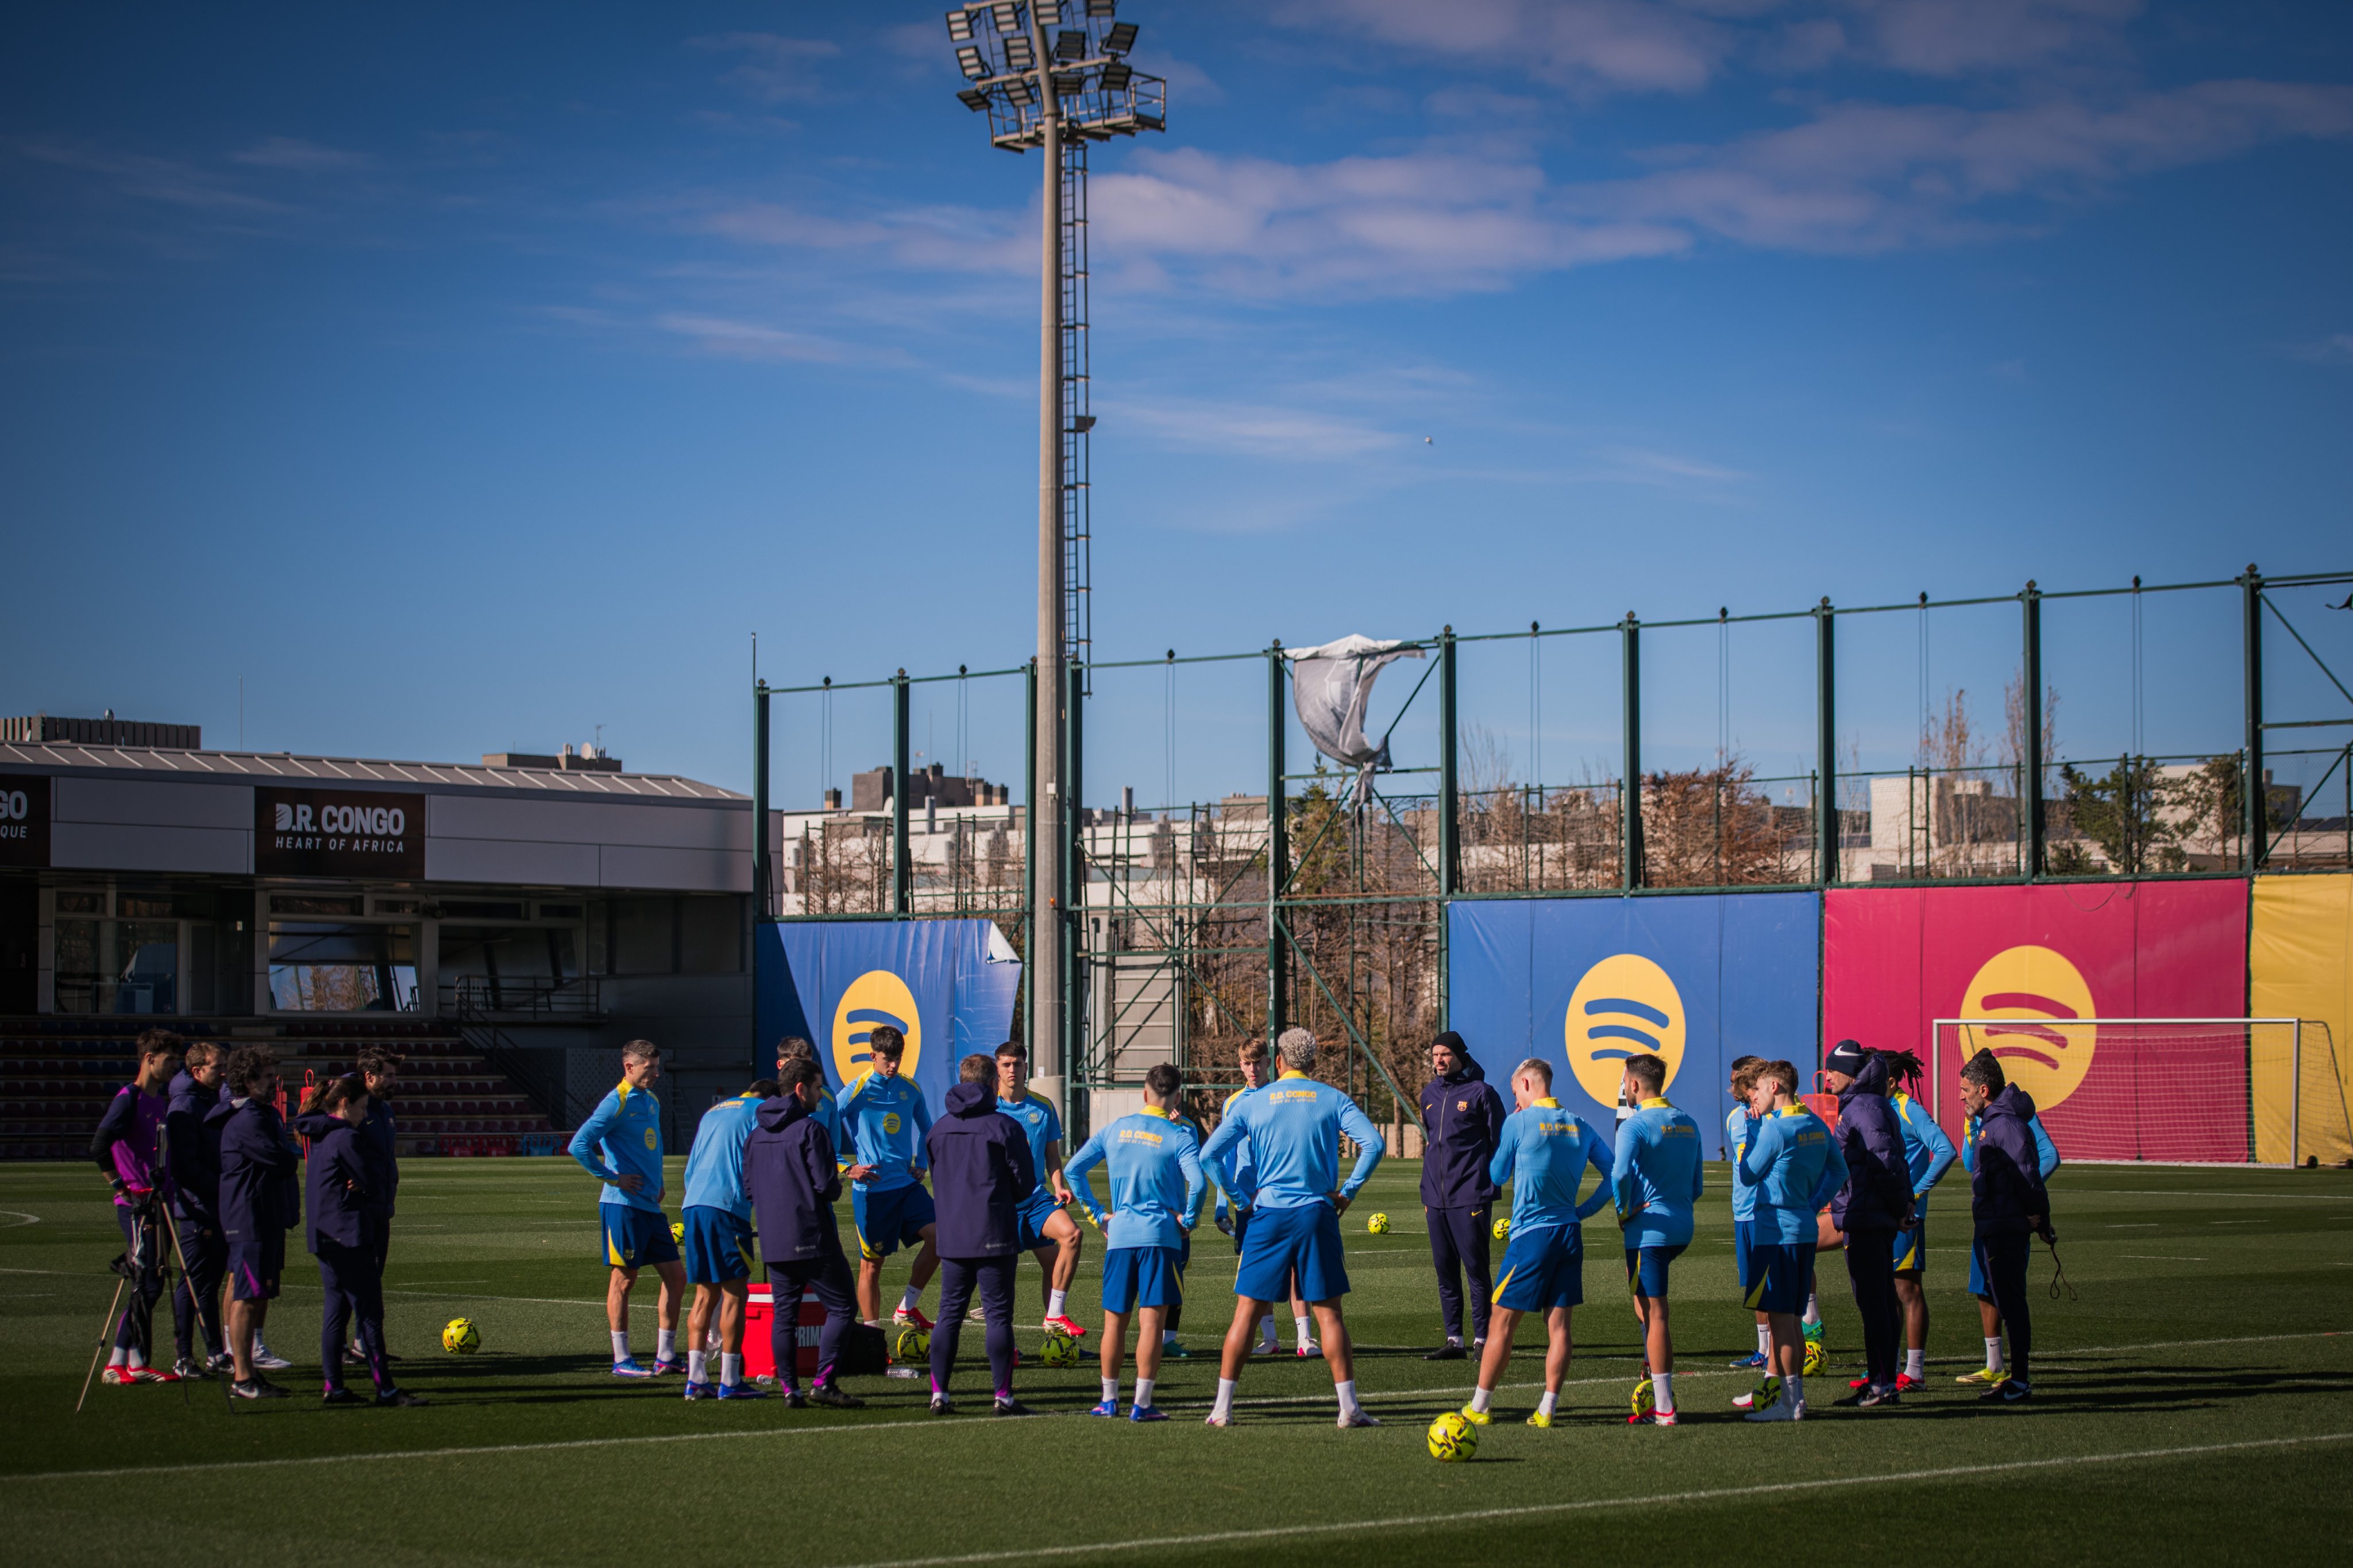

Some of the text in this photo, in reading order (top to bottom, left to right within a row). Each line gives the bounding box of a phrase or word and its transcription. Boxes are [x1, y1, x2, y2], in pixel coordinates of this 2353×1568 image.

[276, 803, 405, 836] D.R. CONGO
[276, 836, 404, 853] HEART OF AFRICA
[1286, 1090, 1317, 1098] CONGO
